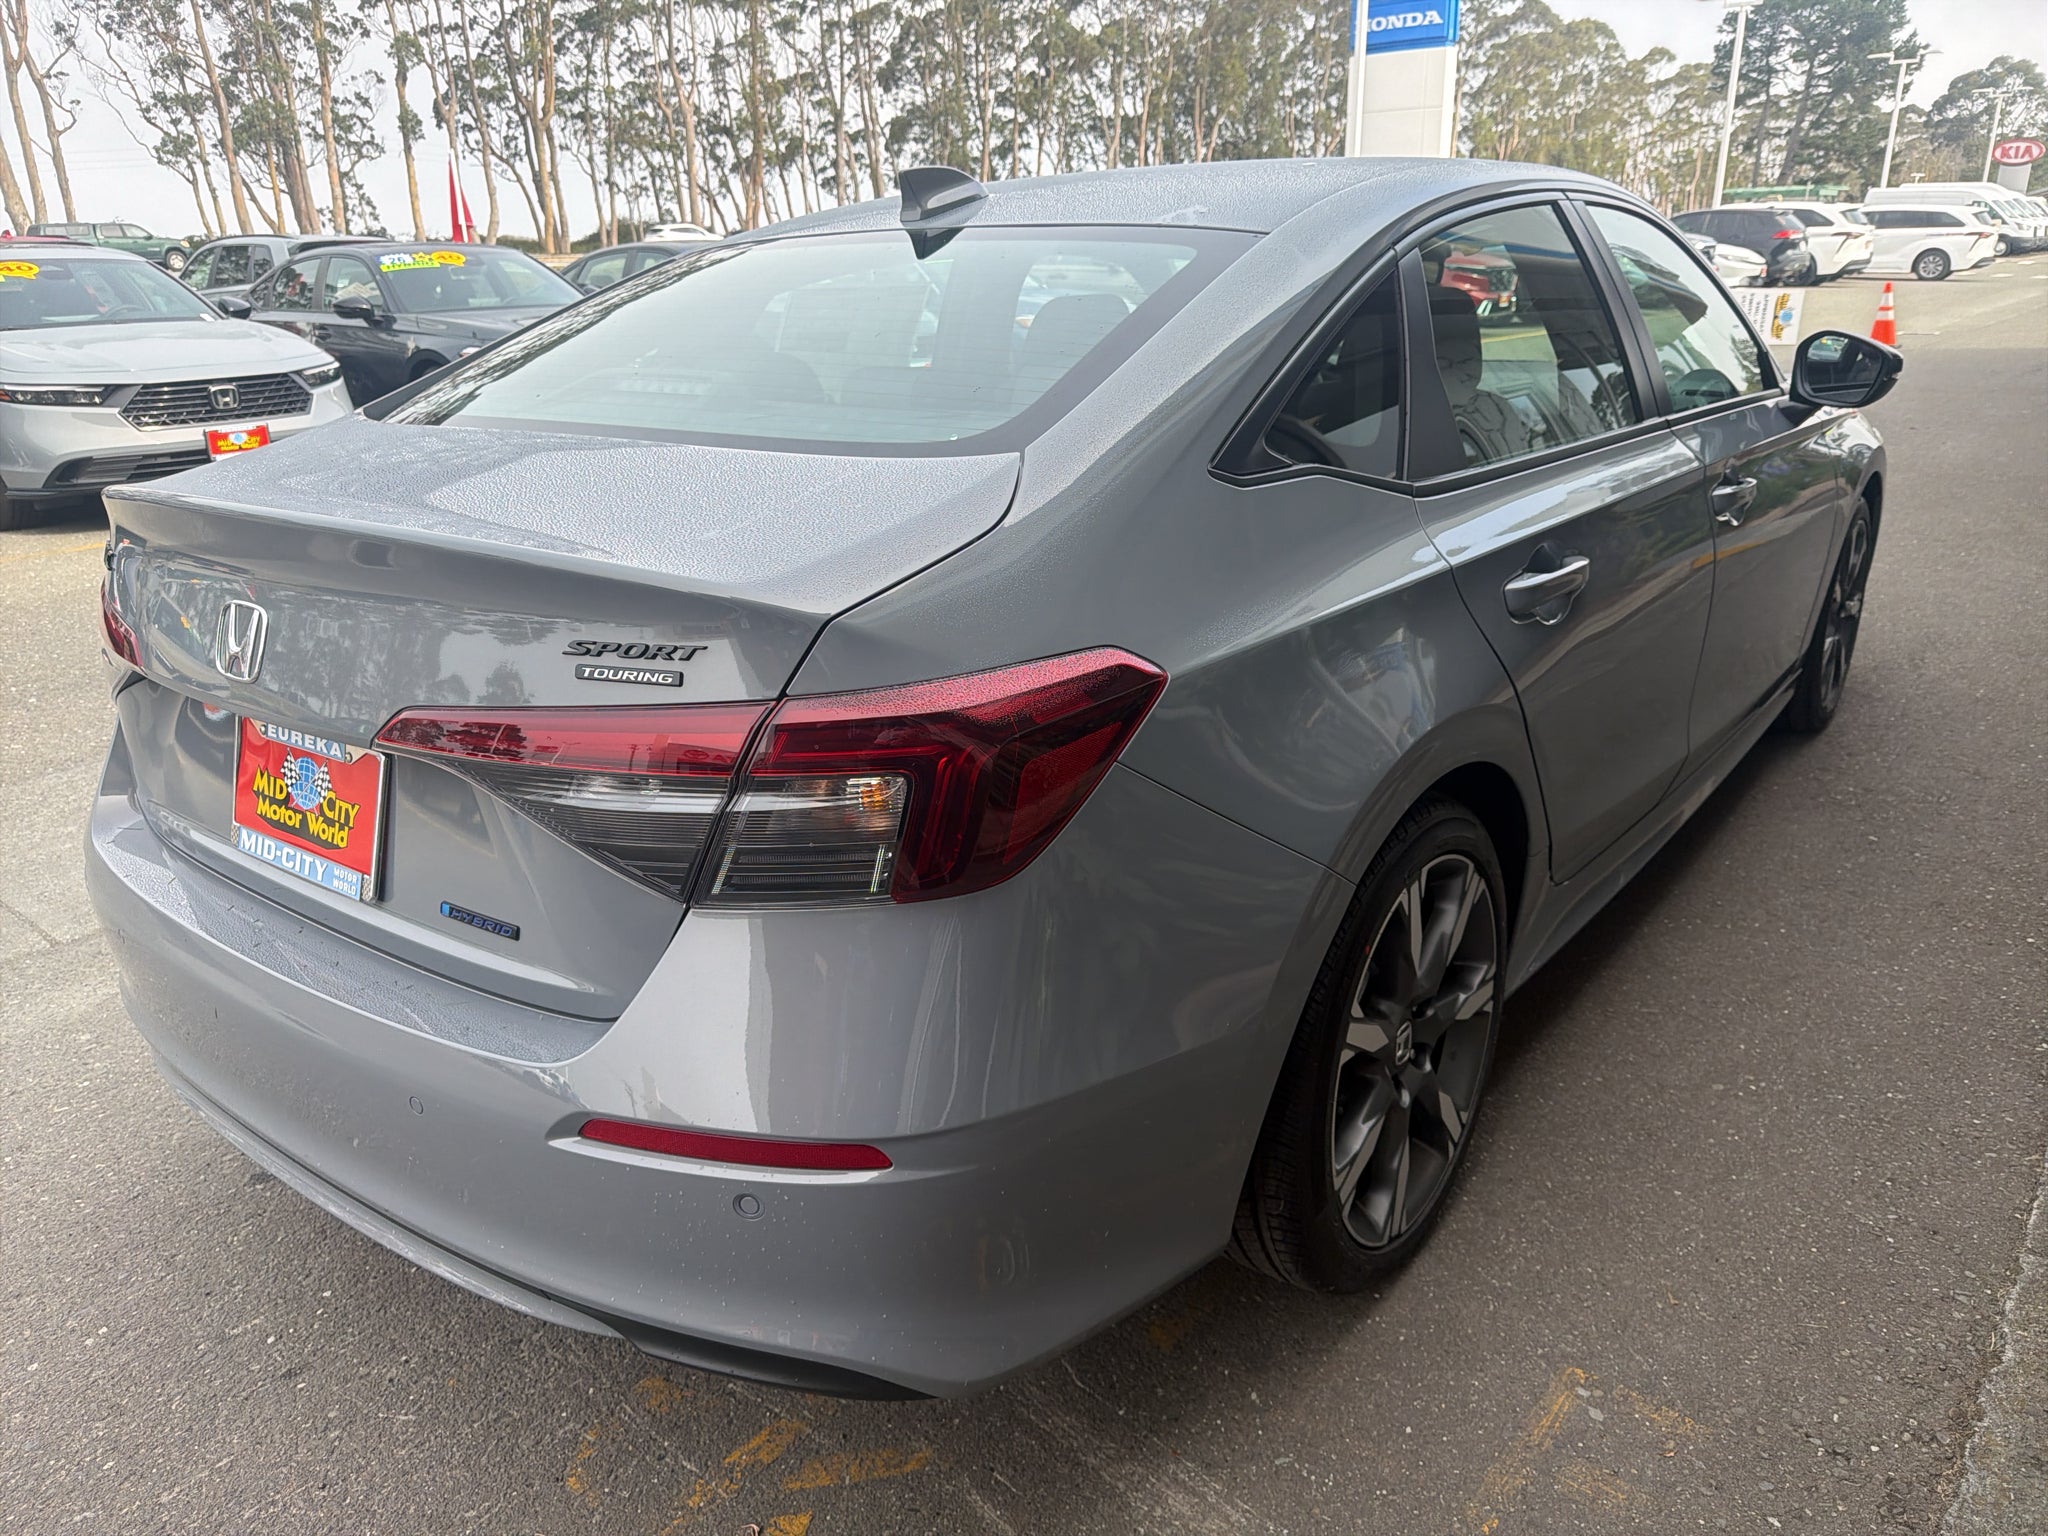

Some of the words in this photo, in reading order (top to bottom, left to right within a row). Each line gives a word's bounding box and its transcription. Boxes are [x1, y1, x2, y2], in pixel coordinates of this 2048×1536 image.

[1366, 10, 1443, 32] ONDA
[2000, 145, 2034, 159] KIA
[562, 640, 708, 661] SPORT
[582, 667, 674, 683] TOURING
[267, 723, 342, 758] EUREKA
[252, 766, 287, 800] MID
[322, 790, 361, 827] CITY
[256, 795, 302, 829] Motor
[306, 811, 349, 848] World
[240, 829, 328, 882] MID-CITY
[333, 867, 357, 884] MOTOR
[333, 878, 356, 896] WORLD
[450, 907, 513, 937] HYBRID
